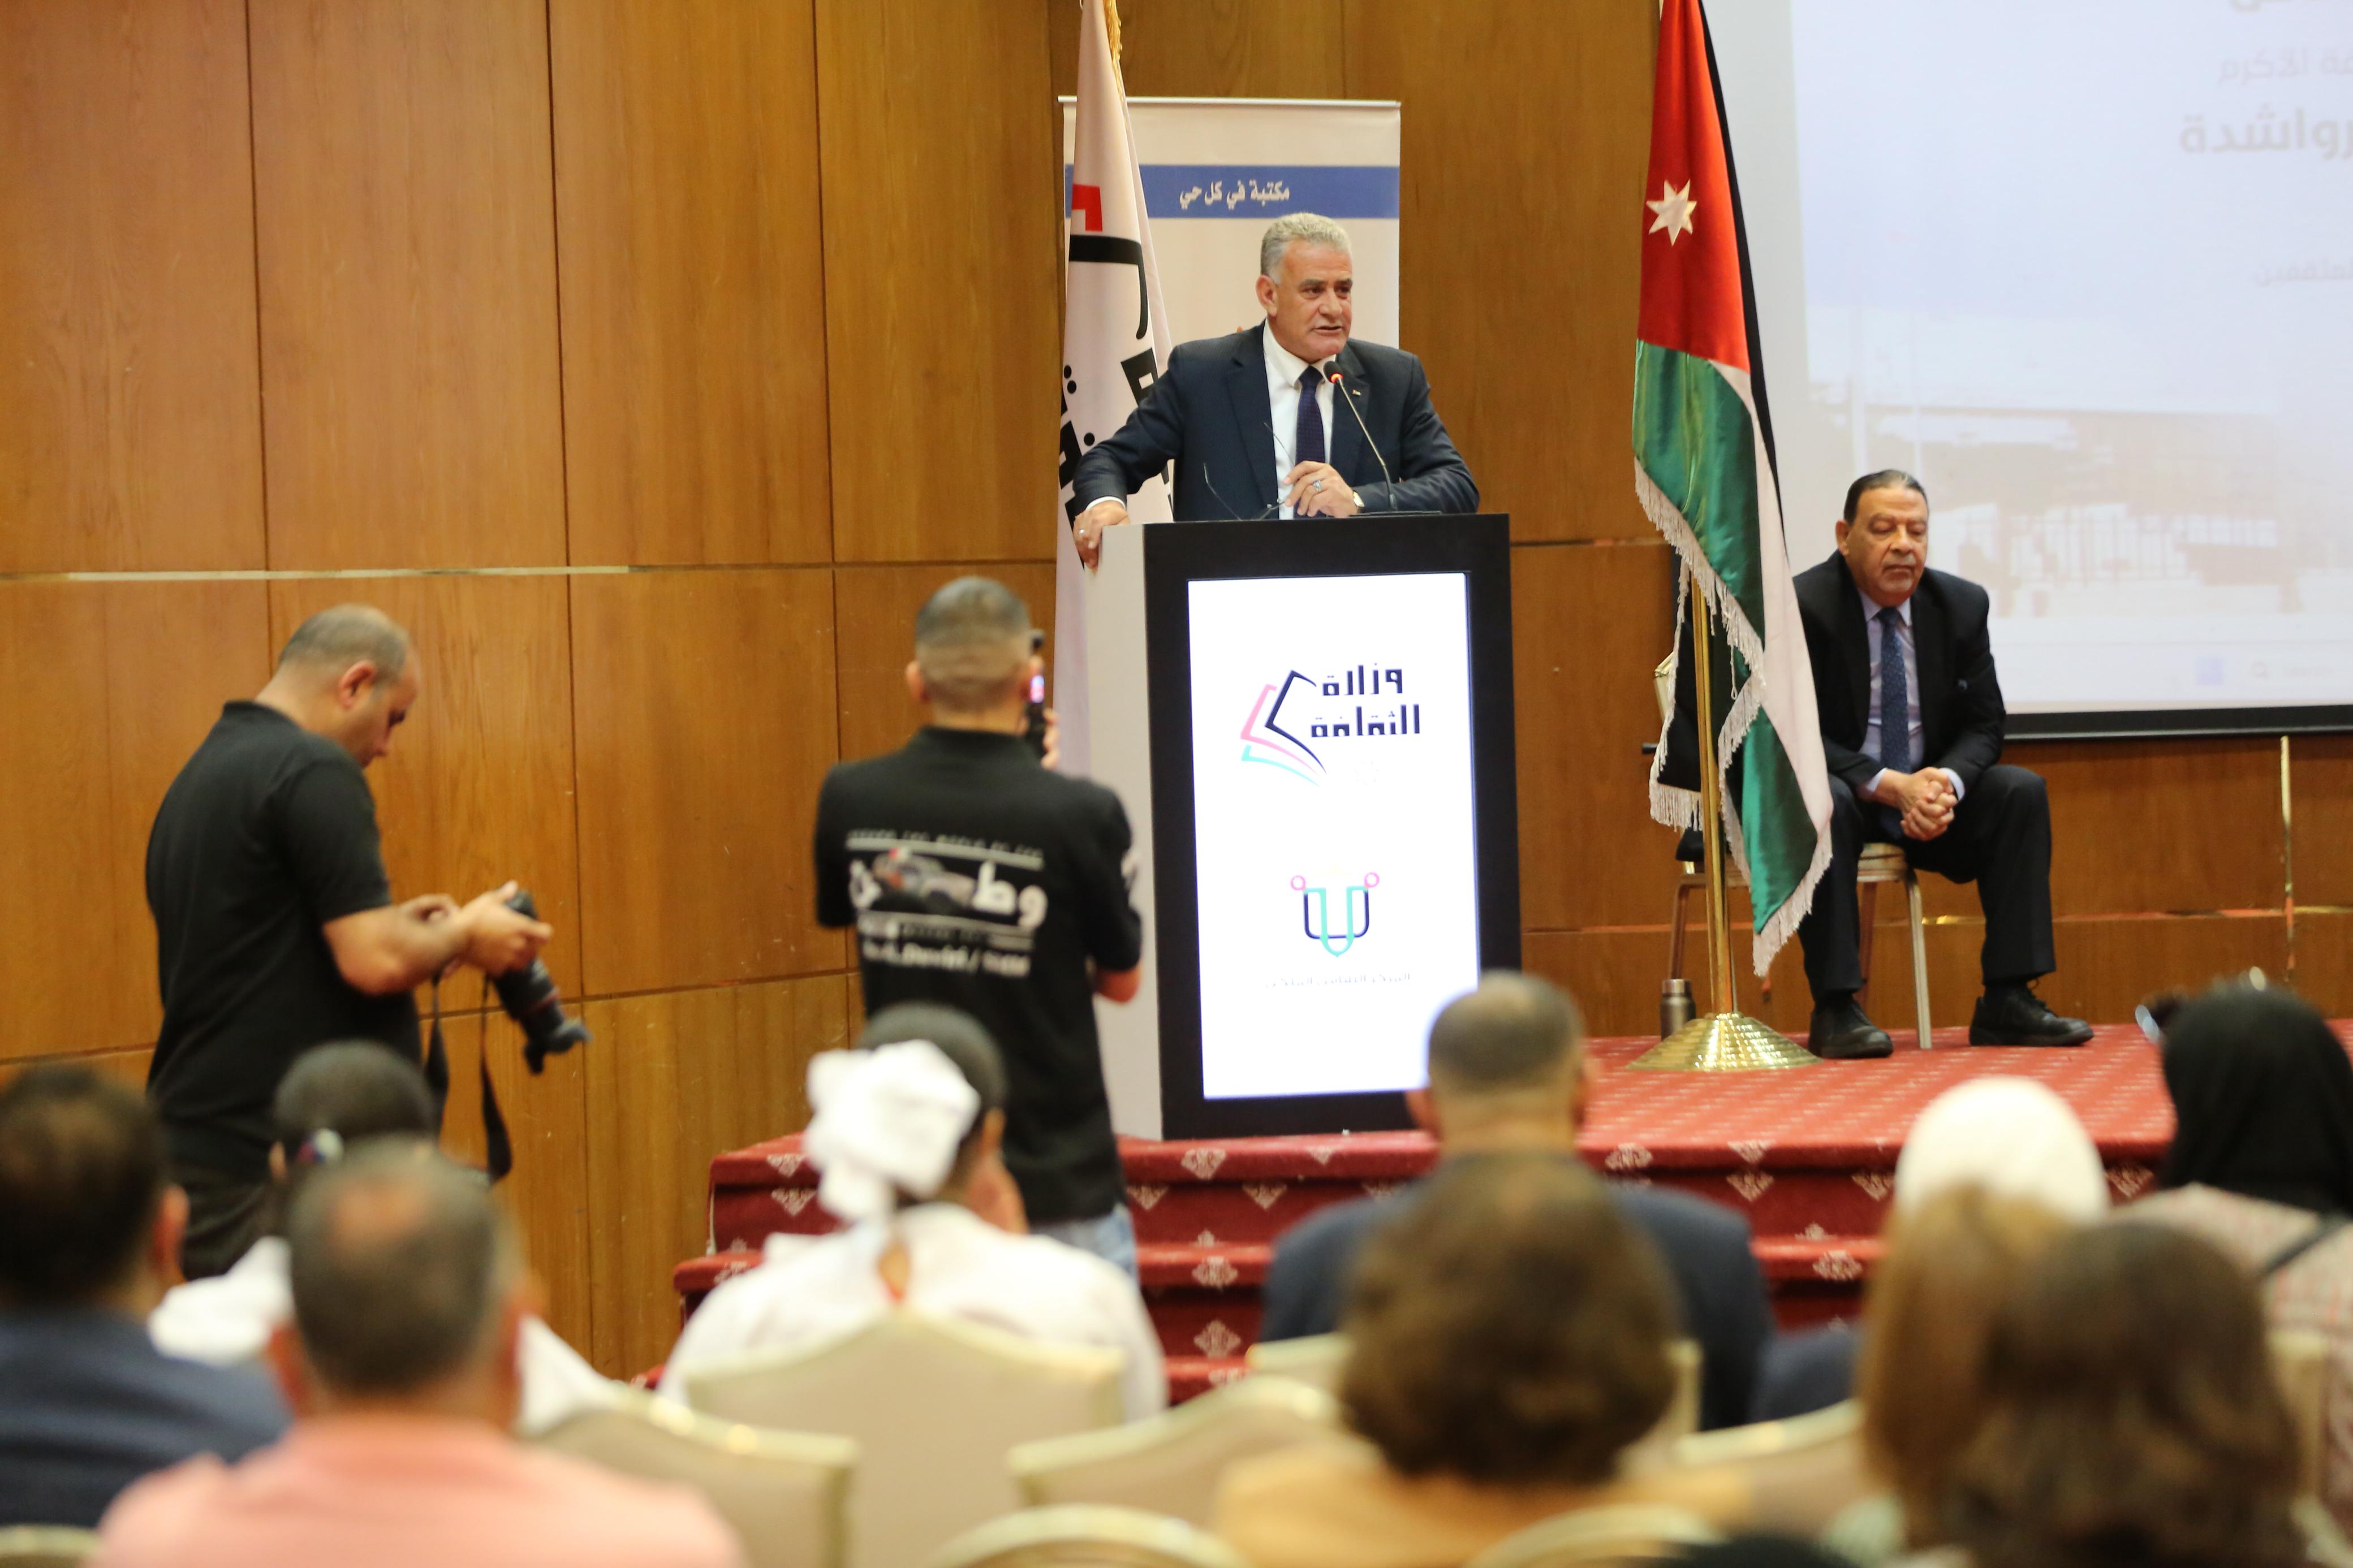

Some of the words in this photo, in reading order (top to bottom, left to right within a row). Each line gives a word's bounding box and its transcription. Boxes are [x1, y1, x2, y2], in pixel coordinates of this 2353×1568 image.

[1179, 185, 1203, 210] حي
[1204, 180, 1222, 206] كل
[1226, 179, 1246, 210] في
[1248, 179, 1290, 207] مكتبة
[1311, 703, 1420, 737] الثقافة
